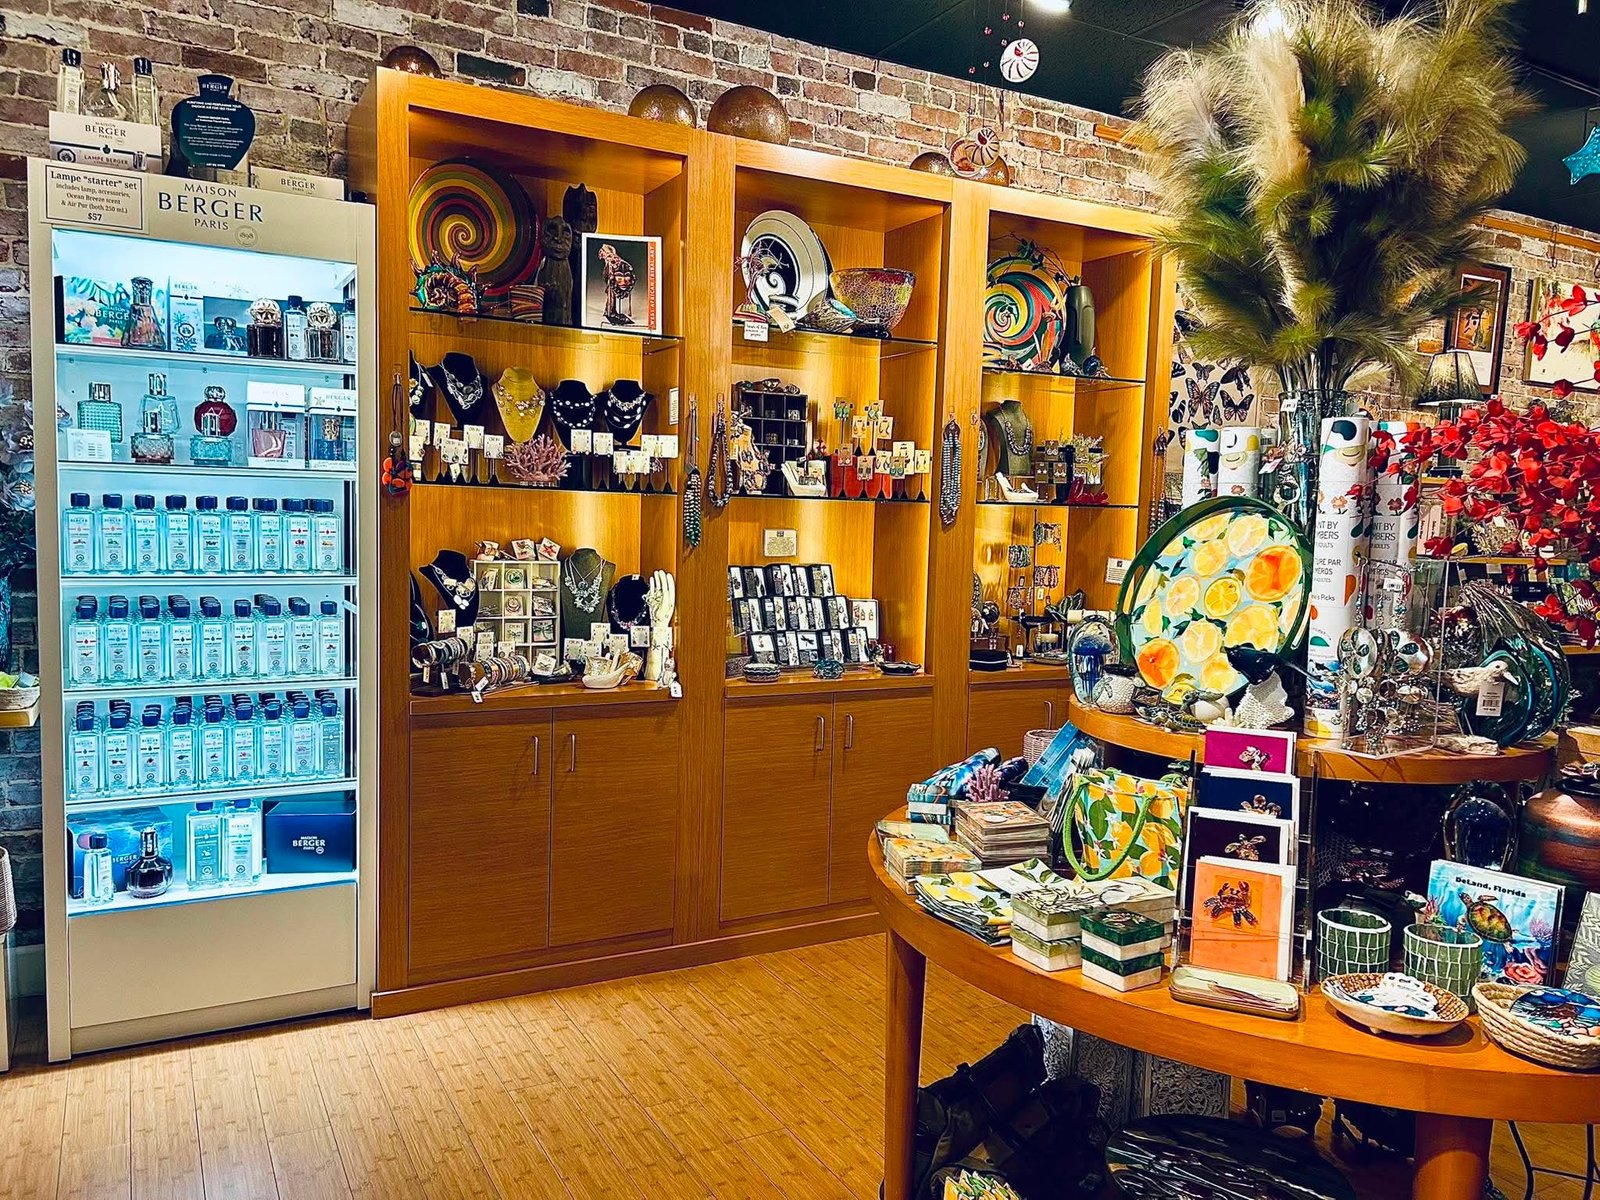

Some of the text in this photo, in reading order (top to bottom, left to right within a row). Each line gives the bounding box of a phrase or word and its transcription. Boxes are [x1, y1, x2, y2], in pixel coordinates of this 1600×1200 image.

[85, 124, 127, 137] BERGER
[51, 171, 138, 190] Lampe "starter" set
[281, 178, 316, 190] BERGER
[55, 183, 80, 192] includes
[184, 183, 237, 198] MAISON
[66, 192, 85, 200] Ocean
[85, 194, 105, 202] Breeze
[88, 203, 105, 212] (both
[158, 192, 263, 223] BERGER
[87, 212, 103, 221] $57
[194, 218, 229, 231] PARIS
[95, 309, 131, 320] BERGE
[1327, 521, 1339, 530] BY
[1383, 522, 1396, 531] BY
[292, 839, 326, 847] BERGER
[1455, 876, 1527, 898] DeLand, Florida
